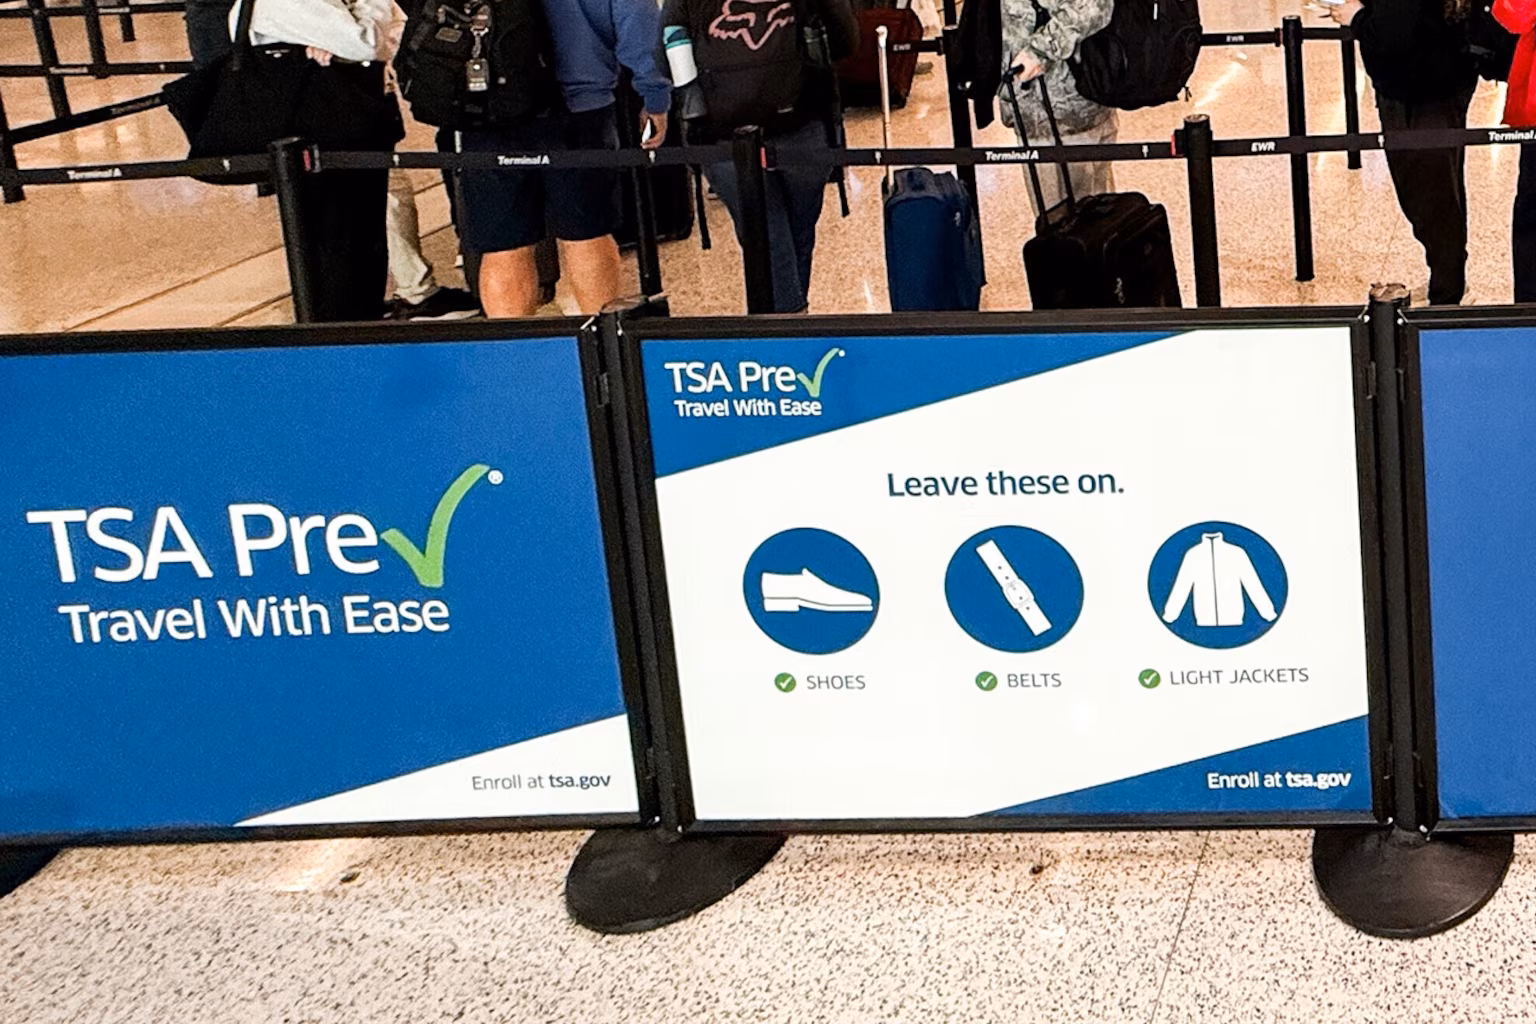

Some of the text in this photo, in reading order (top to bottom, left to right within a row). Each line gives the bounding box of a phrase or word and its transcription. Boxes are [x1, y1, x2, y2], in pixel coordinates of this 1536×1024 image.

[1488, 129, 1533, 141] Terminal
[985, 149, 1039, 161] Terminal A
[1251, 141, 1276, 153] EWR
[497, 155, 550, 166] Terminal A
[664, 361, 797, 393] TSA Pre
[673, 395, 822, 417] Travel With Ease
[887, 470, 1124, 497] Leave these on.
[26, 503, 380, 583] TSA Pre
[57, 595, 450, 644] Travel With Ease
[806, 675, 866, 690] SHOES
[1007, 672, 1062, 688] BELTS
[1170, 667, 1309, 686] LIGHT JACKETS
[471, 774, 611, 791] Enroll at tsa.gov
[1207, 771, 1352, 790] Enroll at tsa.gov
